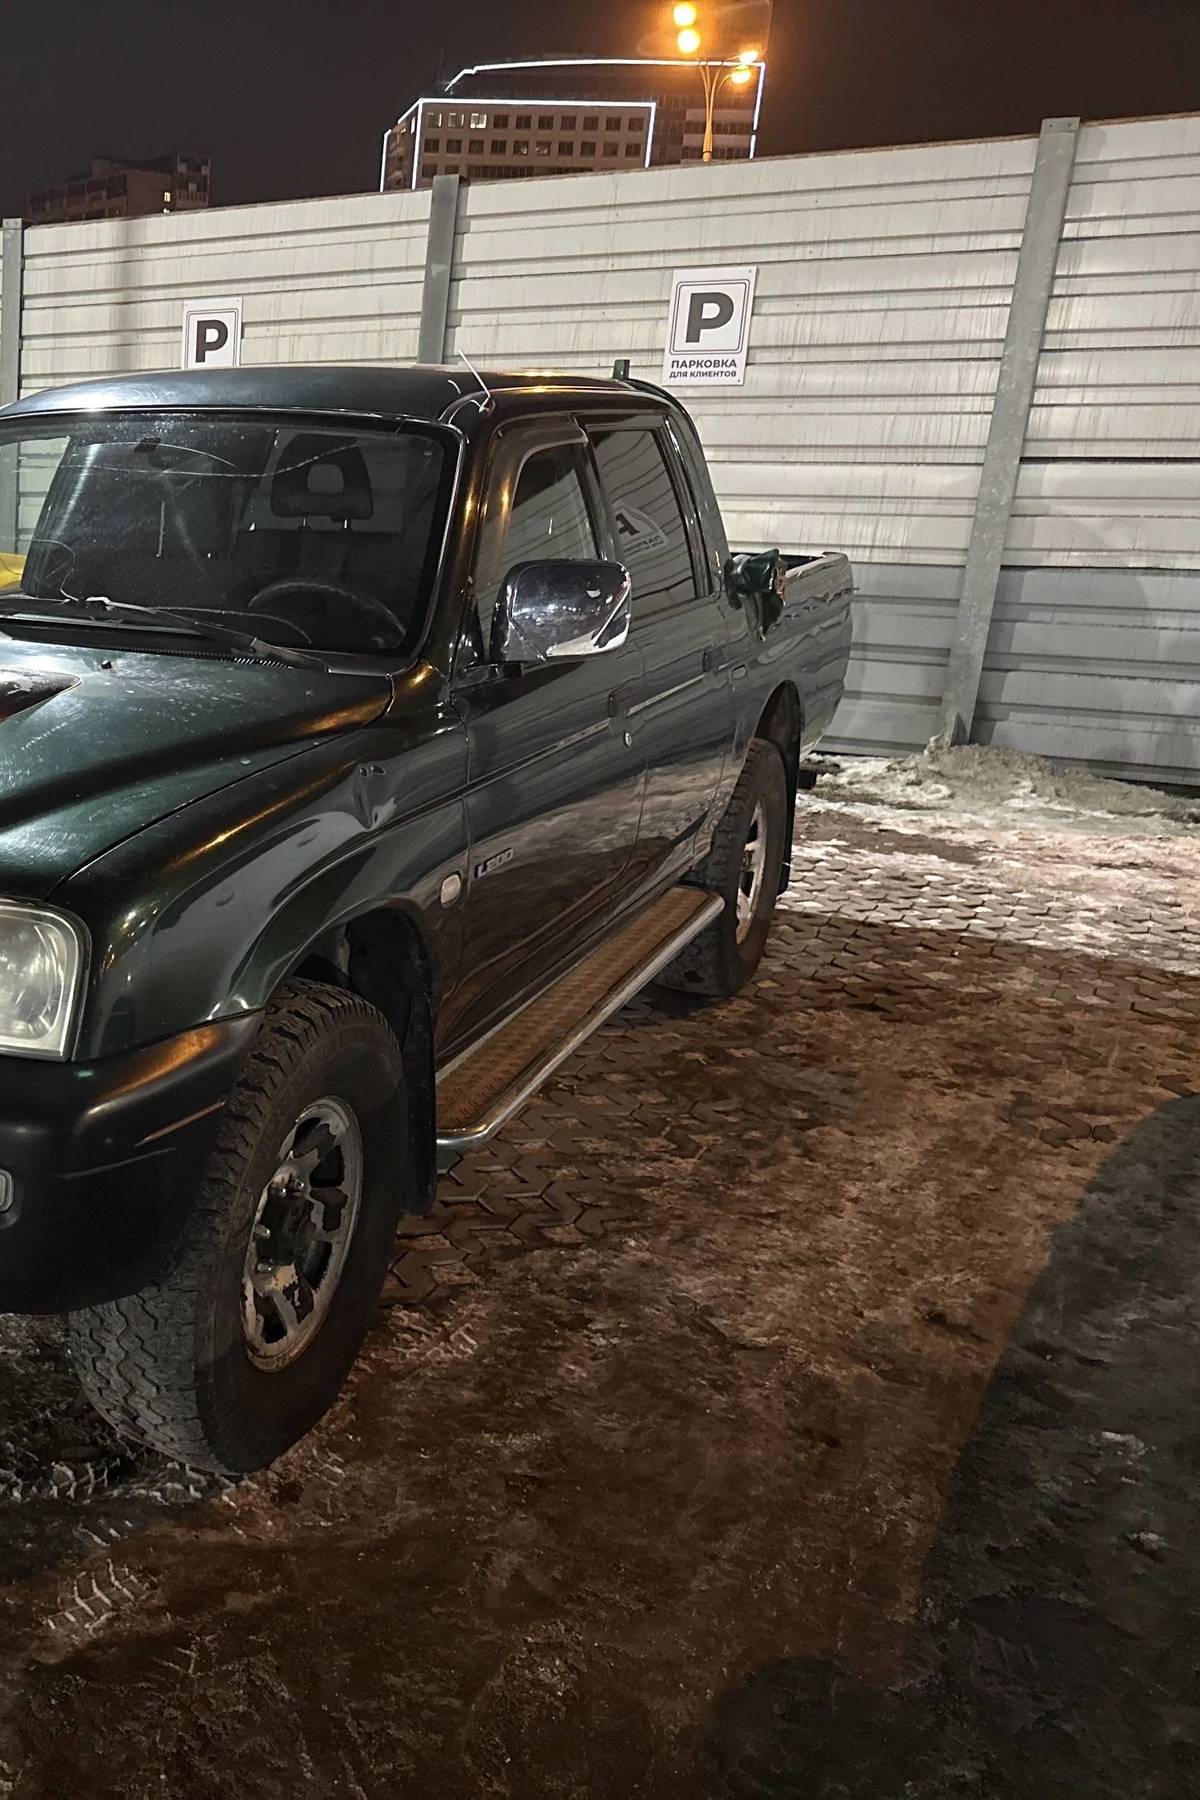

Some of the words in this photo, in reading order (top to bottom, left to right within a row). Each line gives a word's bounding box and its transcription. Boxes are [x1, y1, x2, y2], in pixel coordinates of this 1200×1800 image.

[686, 292, 735, 343] P
[195, 319, 229, 363] P
[669, 371, 688, 379] ДЛЯ
[689, 370, 737, 378] КЛИЕНТОВ
[671, 359, 738, 369] ПАРКОВКА
